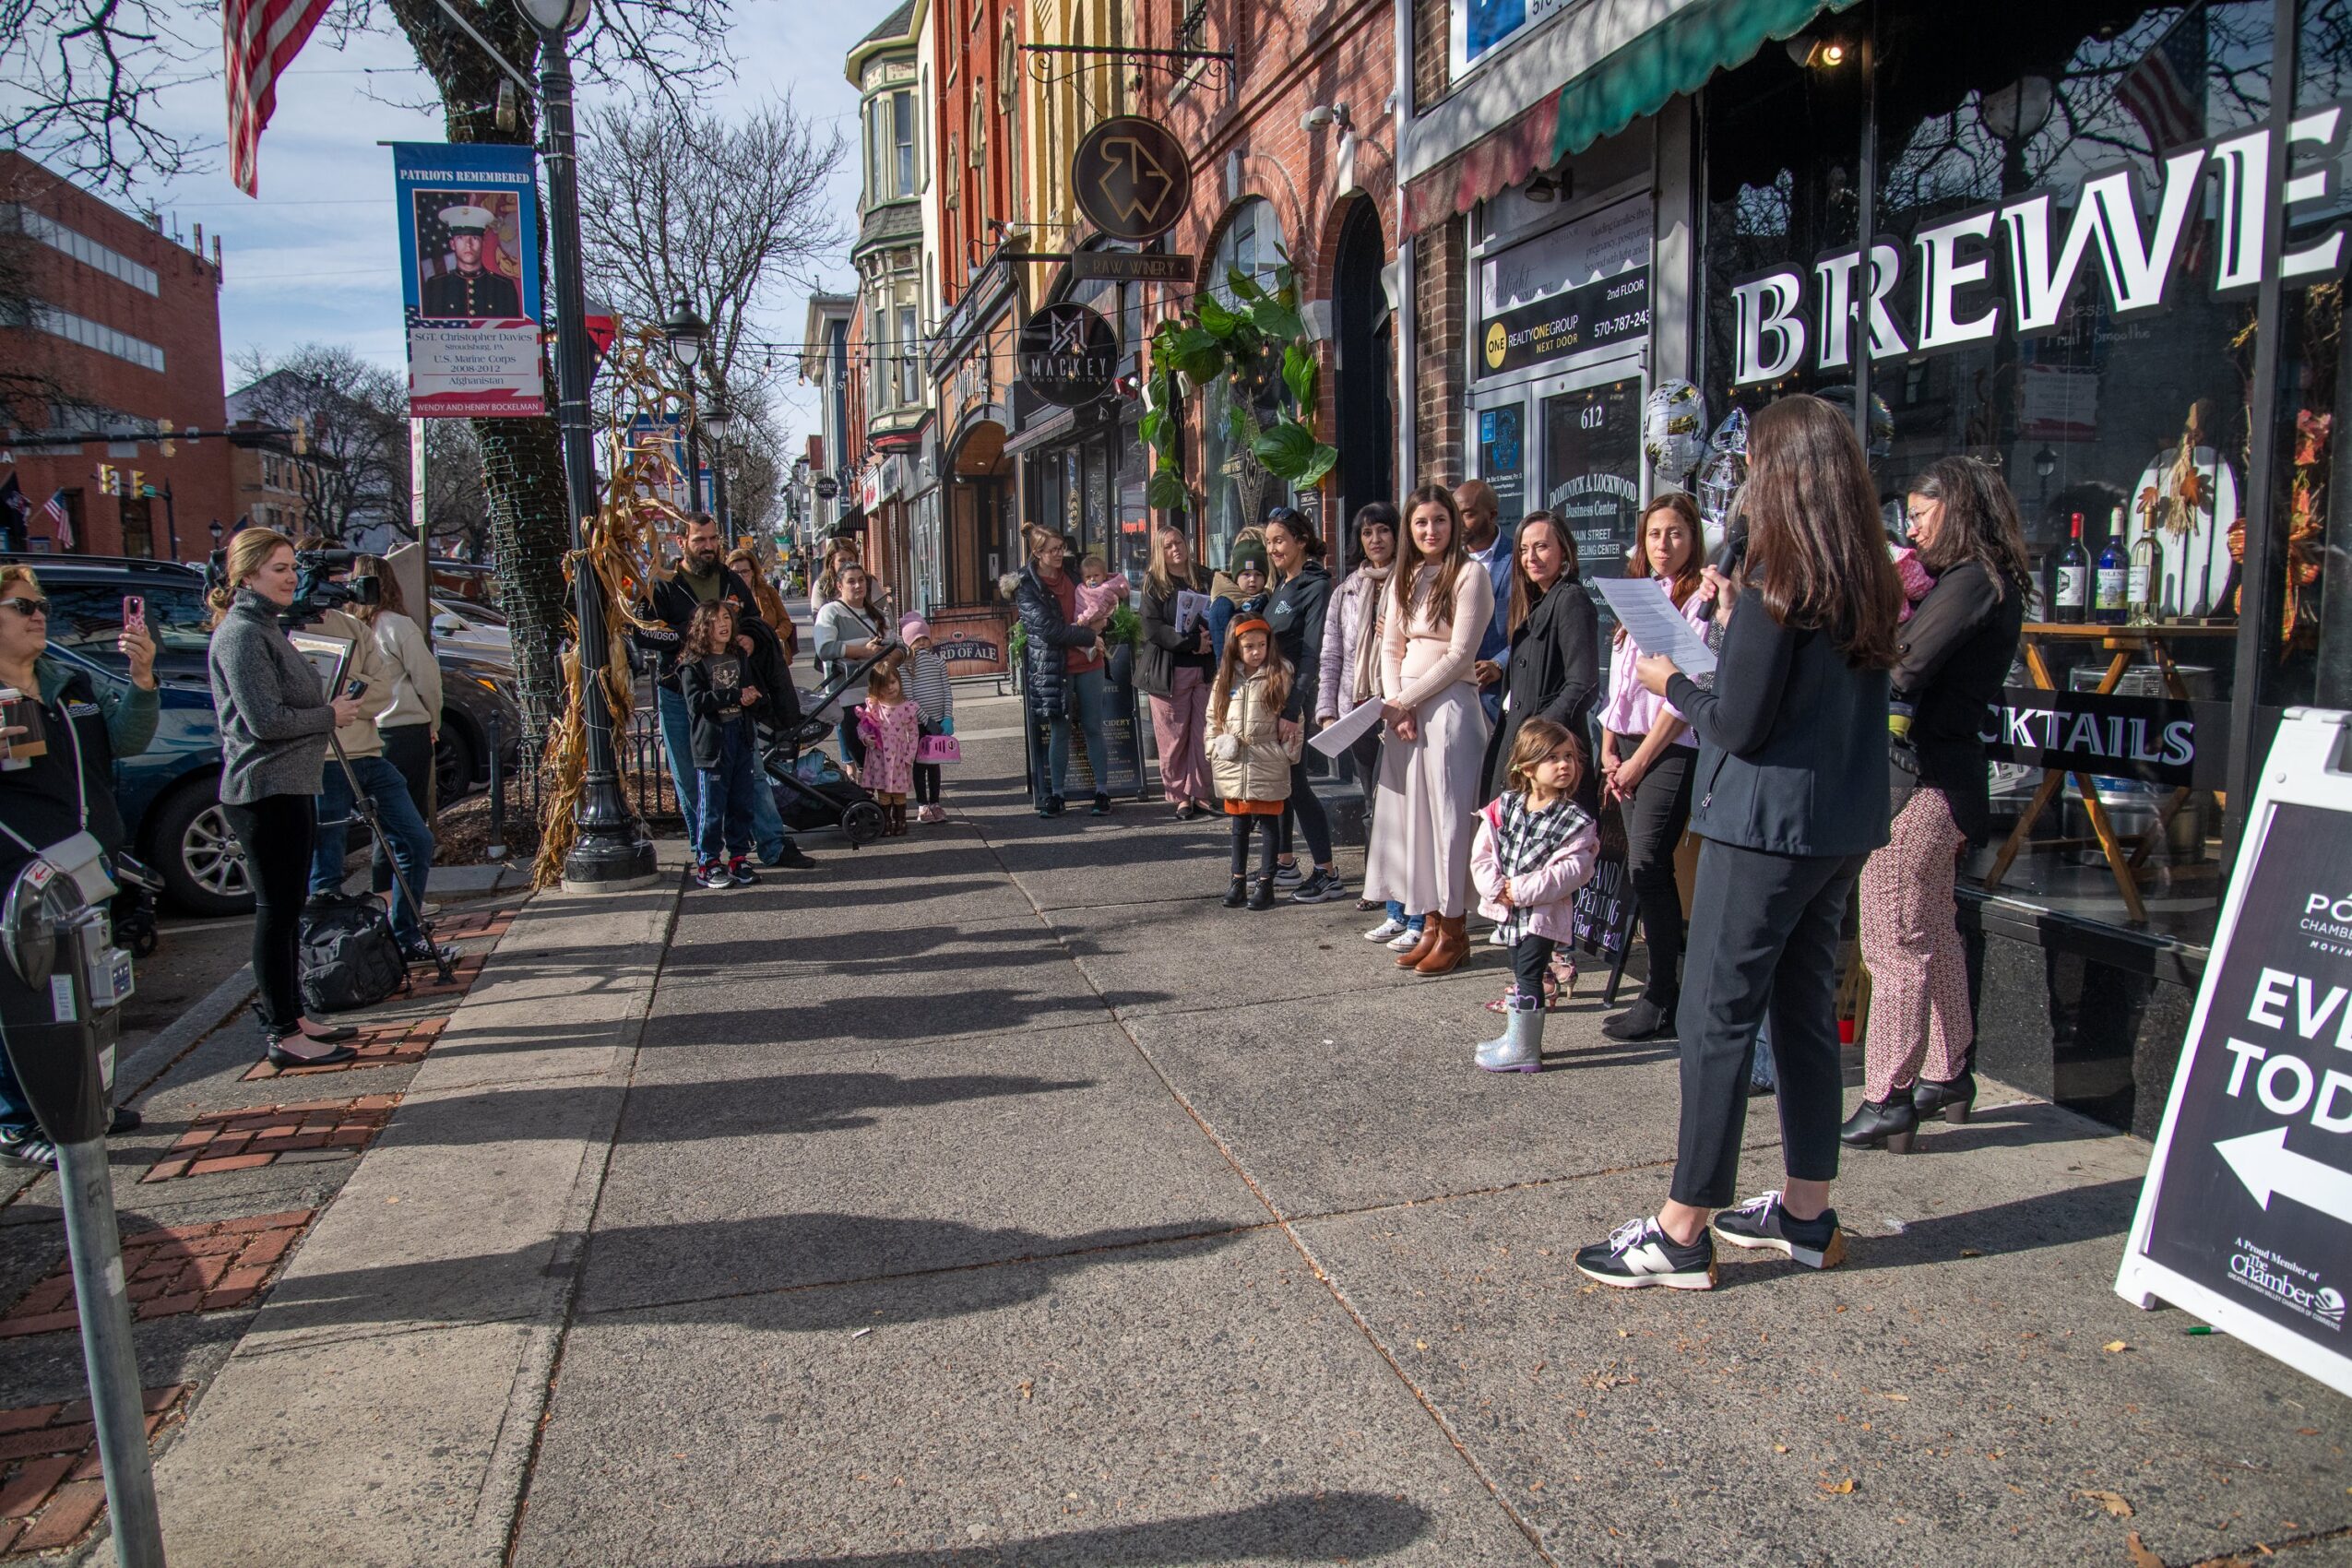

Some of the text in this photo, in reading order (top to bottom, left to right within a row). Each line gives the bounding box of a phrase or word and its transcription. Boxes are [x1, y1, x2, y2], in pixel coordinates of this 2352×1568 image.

[400, 169, 530, 184] PATRIOTS REMEMBERED
[1093, 259, 1176, 276] RAW WINERY
[1607, 279, 1645, 301] 2nd FLOOR
[415, 332, 532, 343] SGT. Christopher Davies
[1488, 337, 1505, 353] ONE
[1536, 333, 1578, 354] NEXT DOOR
[434, 355, 517, 364] U.S. Marine Corps
[1031, 358, 1106, 376] MACKEY
[448, 376, 505, 386] Afghanistan
[417, 403, 539, 412] WENDY AND HENRY BOCKELMAN
[1581, 405, 1603, 430] 612
[1550, 475, 1586, 510] DOMINICK
[1593, 473, 1637, 502] LOCKWOOD
[1565, 500, 1618, 518] Business Center
[1587, 528, 1611, 540] STREET
[1597, 543, 1620, 555] CENTER
[957, 647, 973, 658] OF
[975, 647, 997, 660] ALE
[2226, 1036, 2352, 1134] TOD
[2234, 1237, 2320, 1282] A Proud Member of
[2250, 1253, 2268, 1272] The
[2230, 1253, 2314, 1308] Chamber
[2227, 1272, 2341, 1332] GREATER LEHIGH VALLEY CHAMBER OF COMMERCE
